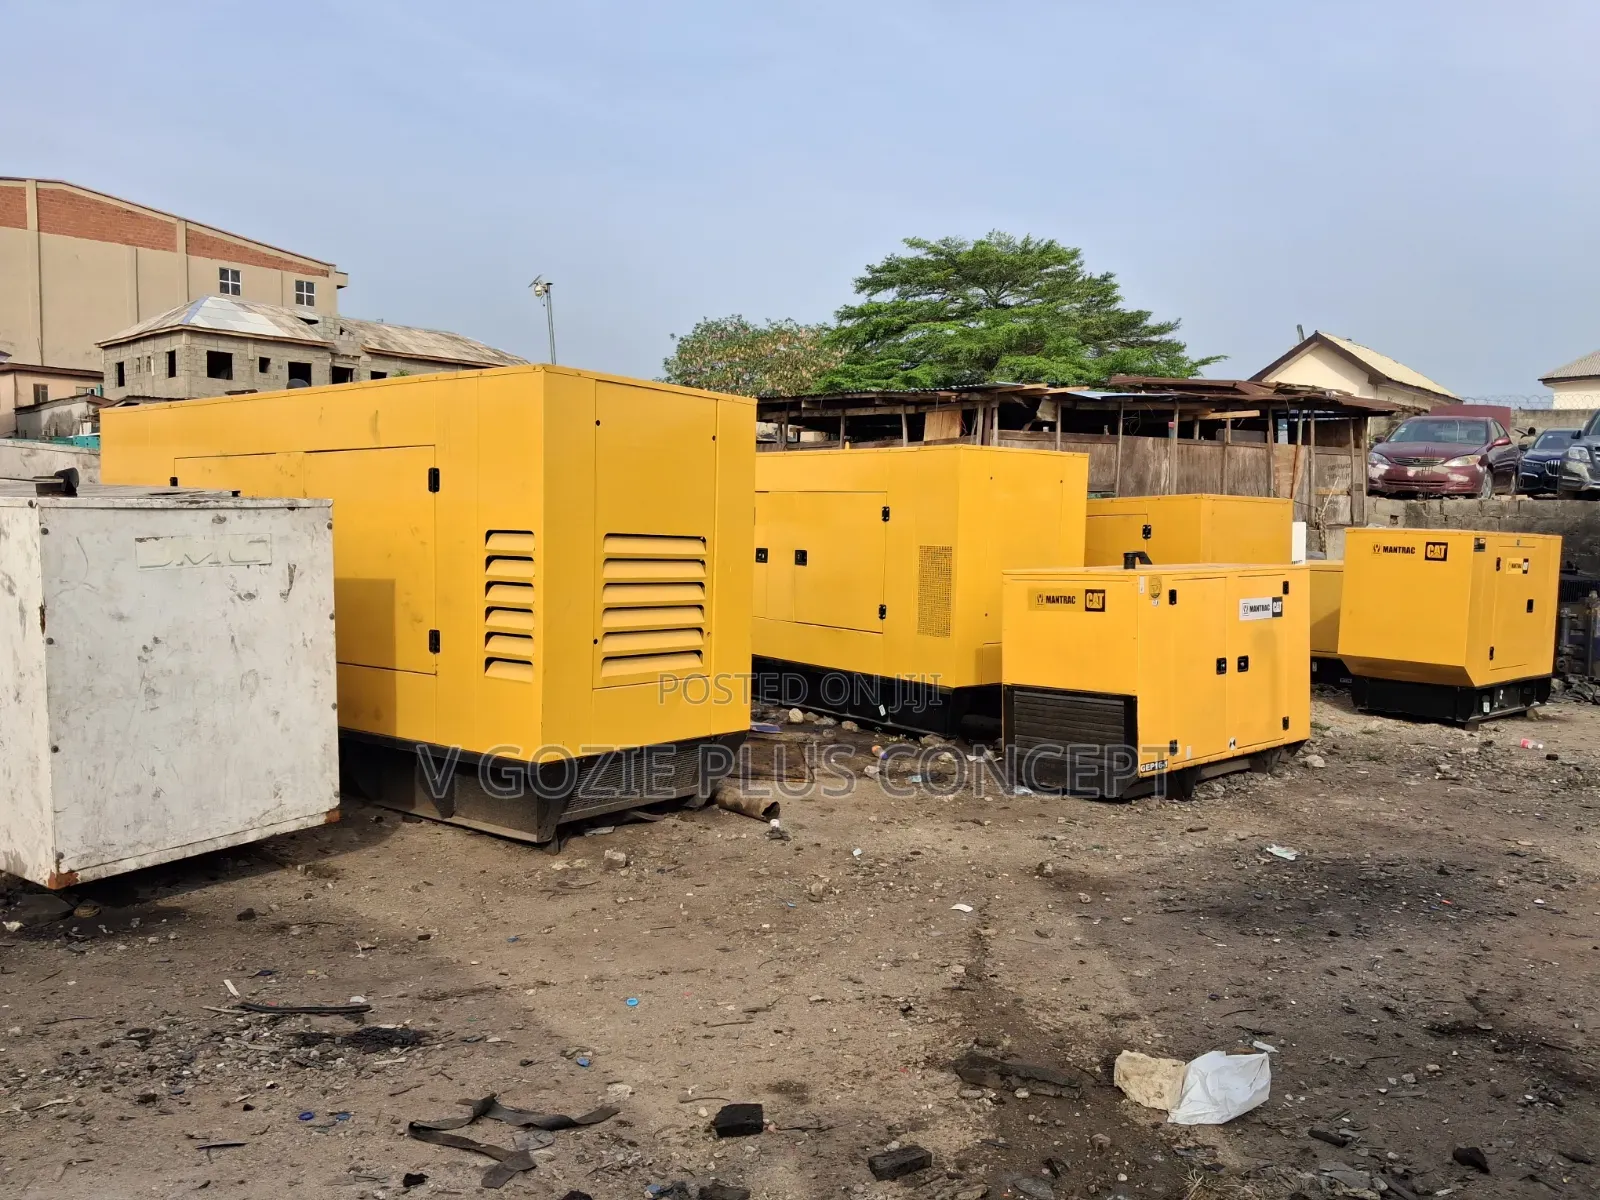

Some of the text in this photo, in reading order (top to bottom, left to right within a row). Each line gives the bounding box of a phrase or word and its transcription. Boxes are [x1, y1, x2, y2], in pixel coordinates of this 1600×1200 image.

[1382, 544, 1447, 559] MANTRAC CAT
[1045, 591, 1105, 609] MANTRAC CAT
